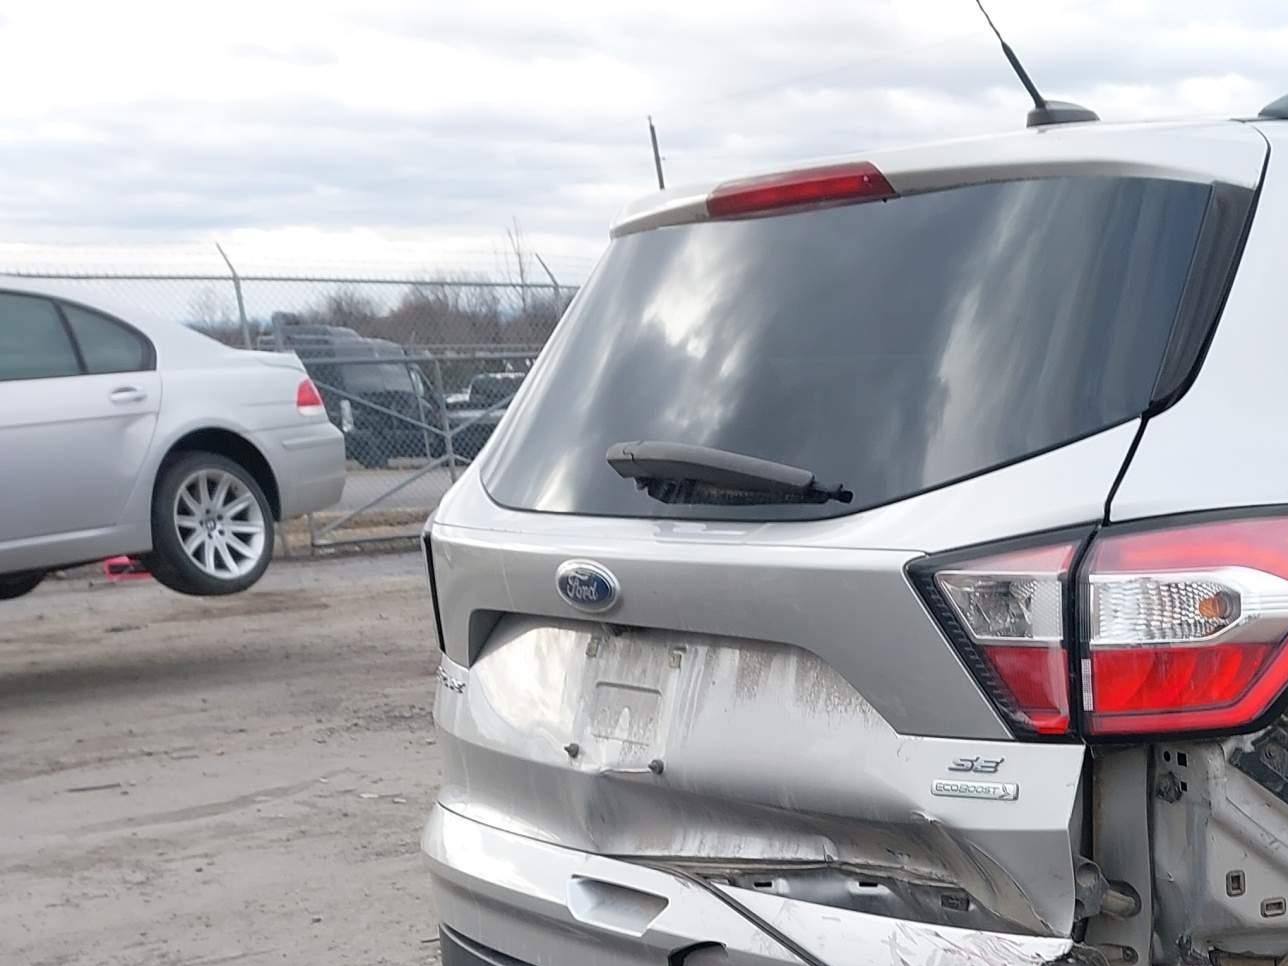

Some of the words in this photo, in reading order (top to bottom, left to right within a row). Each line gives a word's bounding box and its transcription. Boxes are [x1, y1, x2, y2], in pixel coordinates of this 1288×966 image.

[566, 571, 599, 601] Ford
[948, 756, 1005, 774] SE
[934, 782, 1000, 796] ECOBOOST
